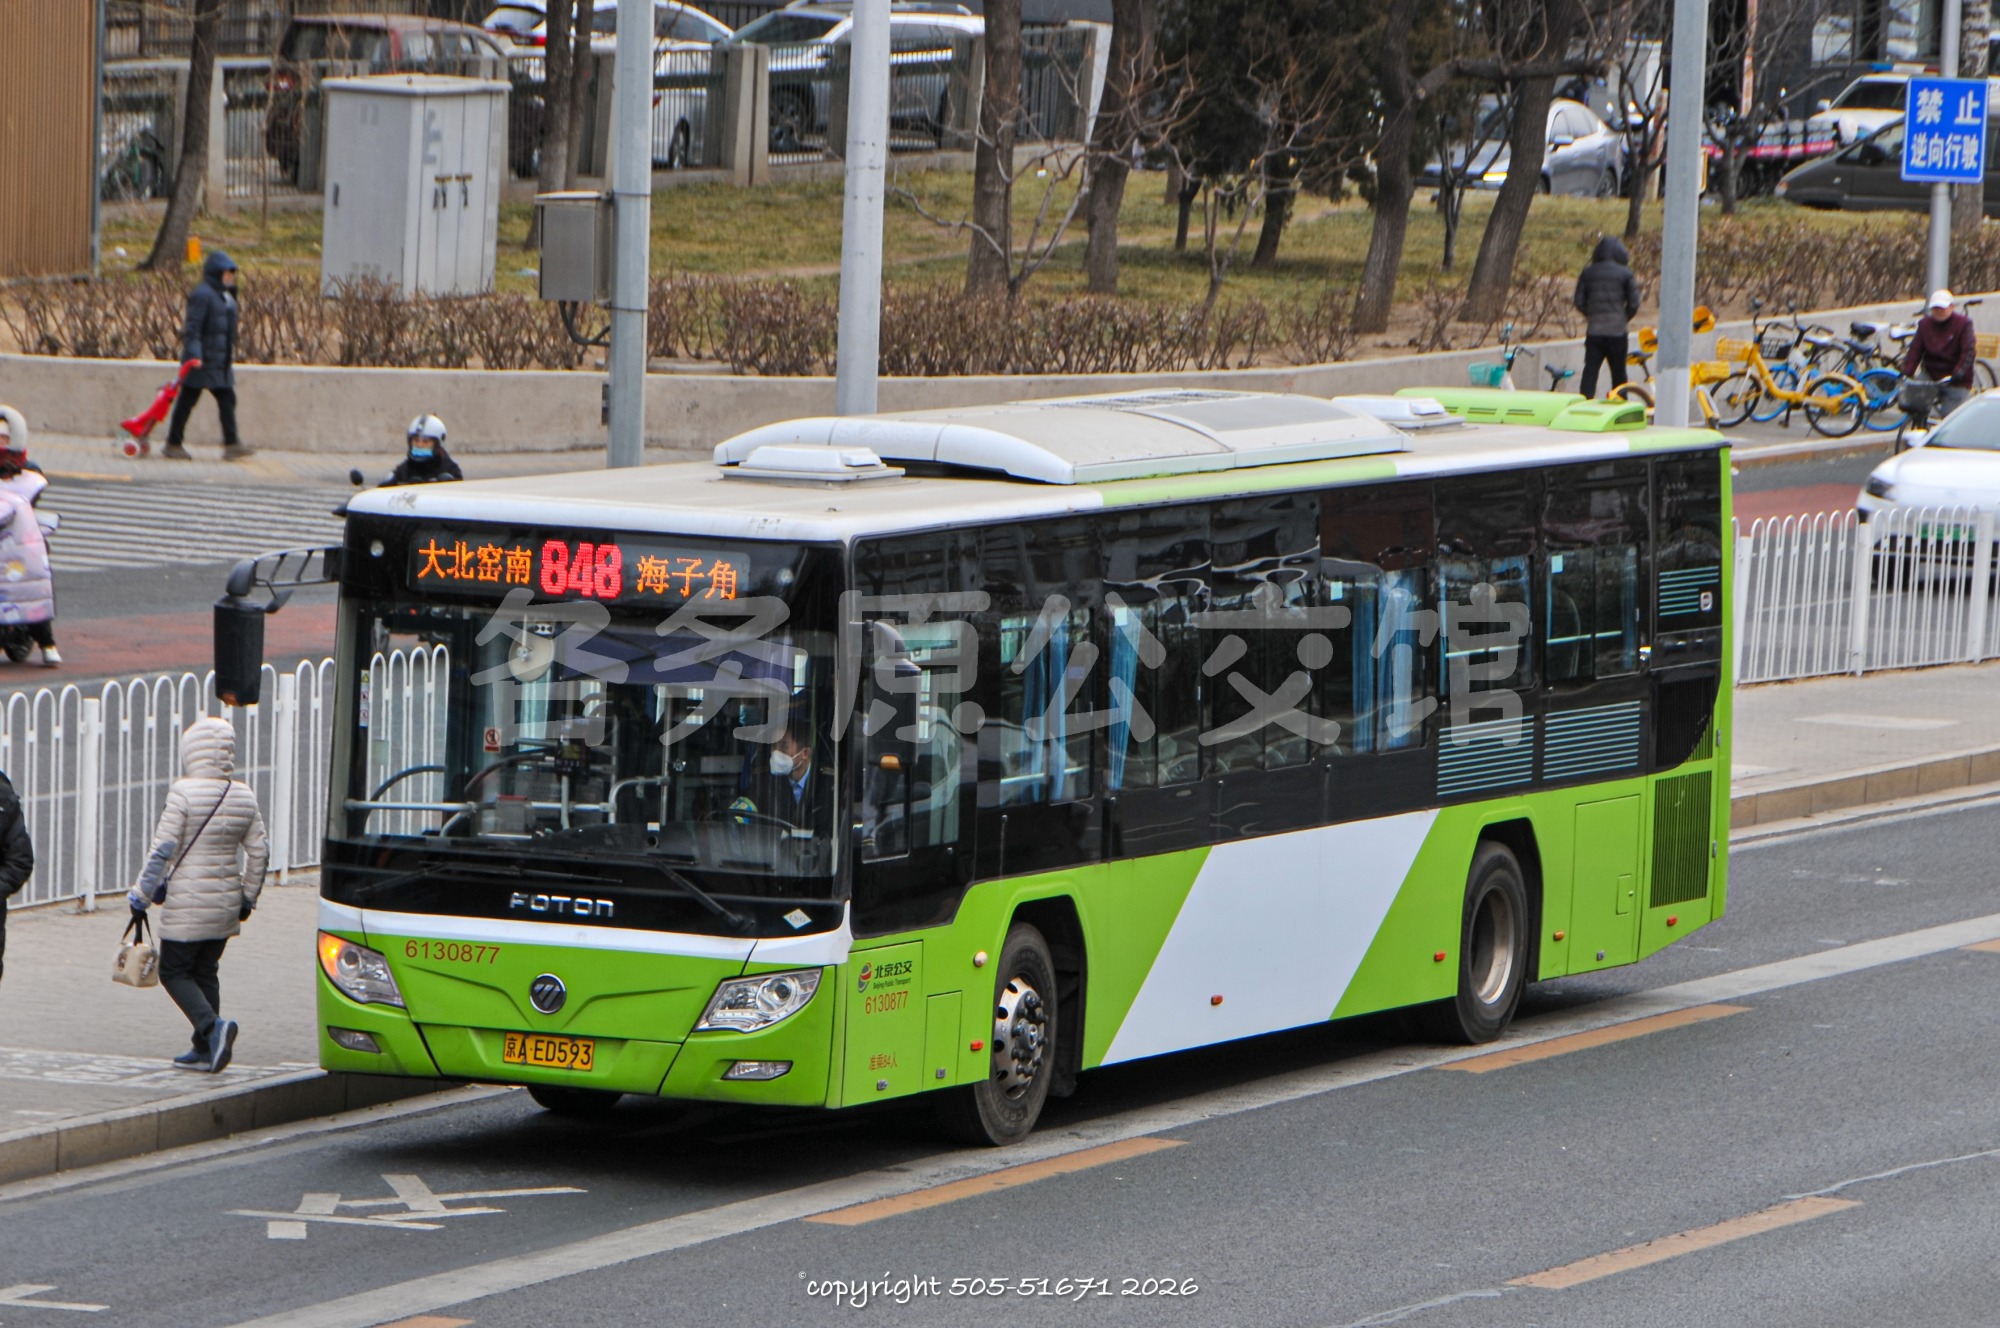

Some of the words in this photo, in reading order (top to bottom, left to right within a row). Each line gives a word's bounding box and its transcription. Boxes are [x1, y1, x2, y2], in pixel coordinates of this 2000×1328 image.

[1916, 88, 1981, 125] 禁止
[1910, 132, 1979, 169] 逆向行驶
[418, 538, 532, 584] 大北窑南
[540, 540, 622, 598] 848
[637, 555, 737, 600] 海子角
[509, 892, 614, 917] FOTON
[405, 940, 500, 964] 6130877
[874, 960, 913, 979] 北京公交
[865, 991, 909, 1014] 6130877
